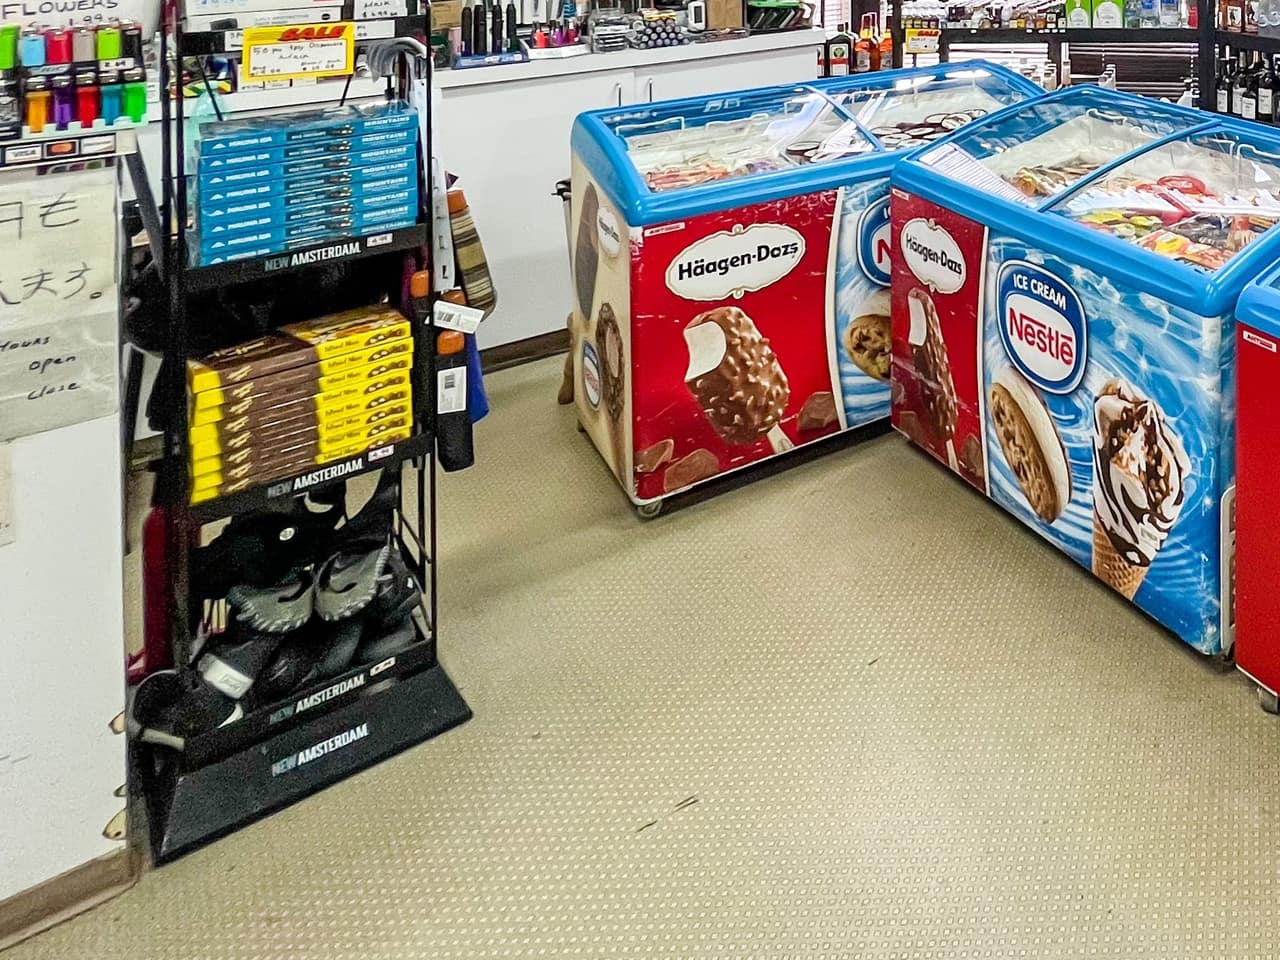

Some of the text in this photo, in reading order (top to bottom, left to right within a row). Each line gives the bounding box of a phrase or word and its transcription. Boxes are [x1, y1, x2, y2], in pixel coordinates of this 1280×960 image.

[278, 25, 347, 41] SALE
[264, 241, 361, 272] NEW AMSTERDAM
[677, 241, 799, 281] Häagen-Dazs
[1012, 273, 1067, 311] ICE CREAM
[293, 457, 364, 491] AMSTERDAM
[295, 673, 365, 714] AMSTERDAM
[297, 722, 369, 766] AMSTERDAM
